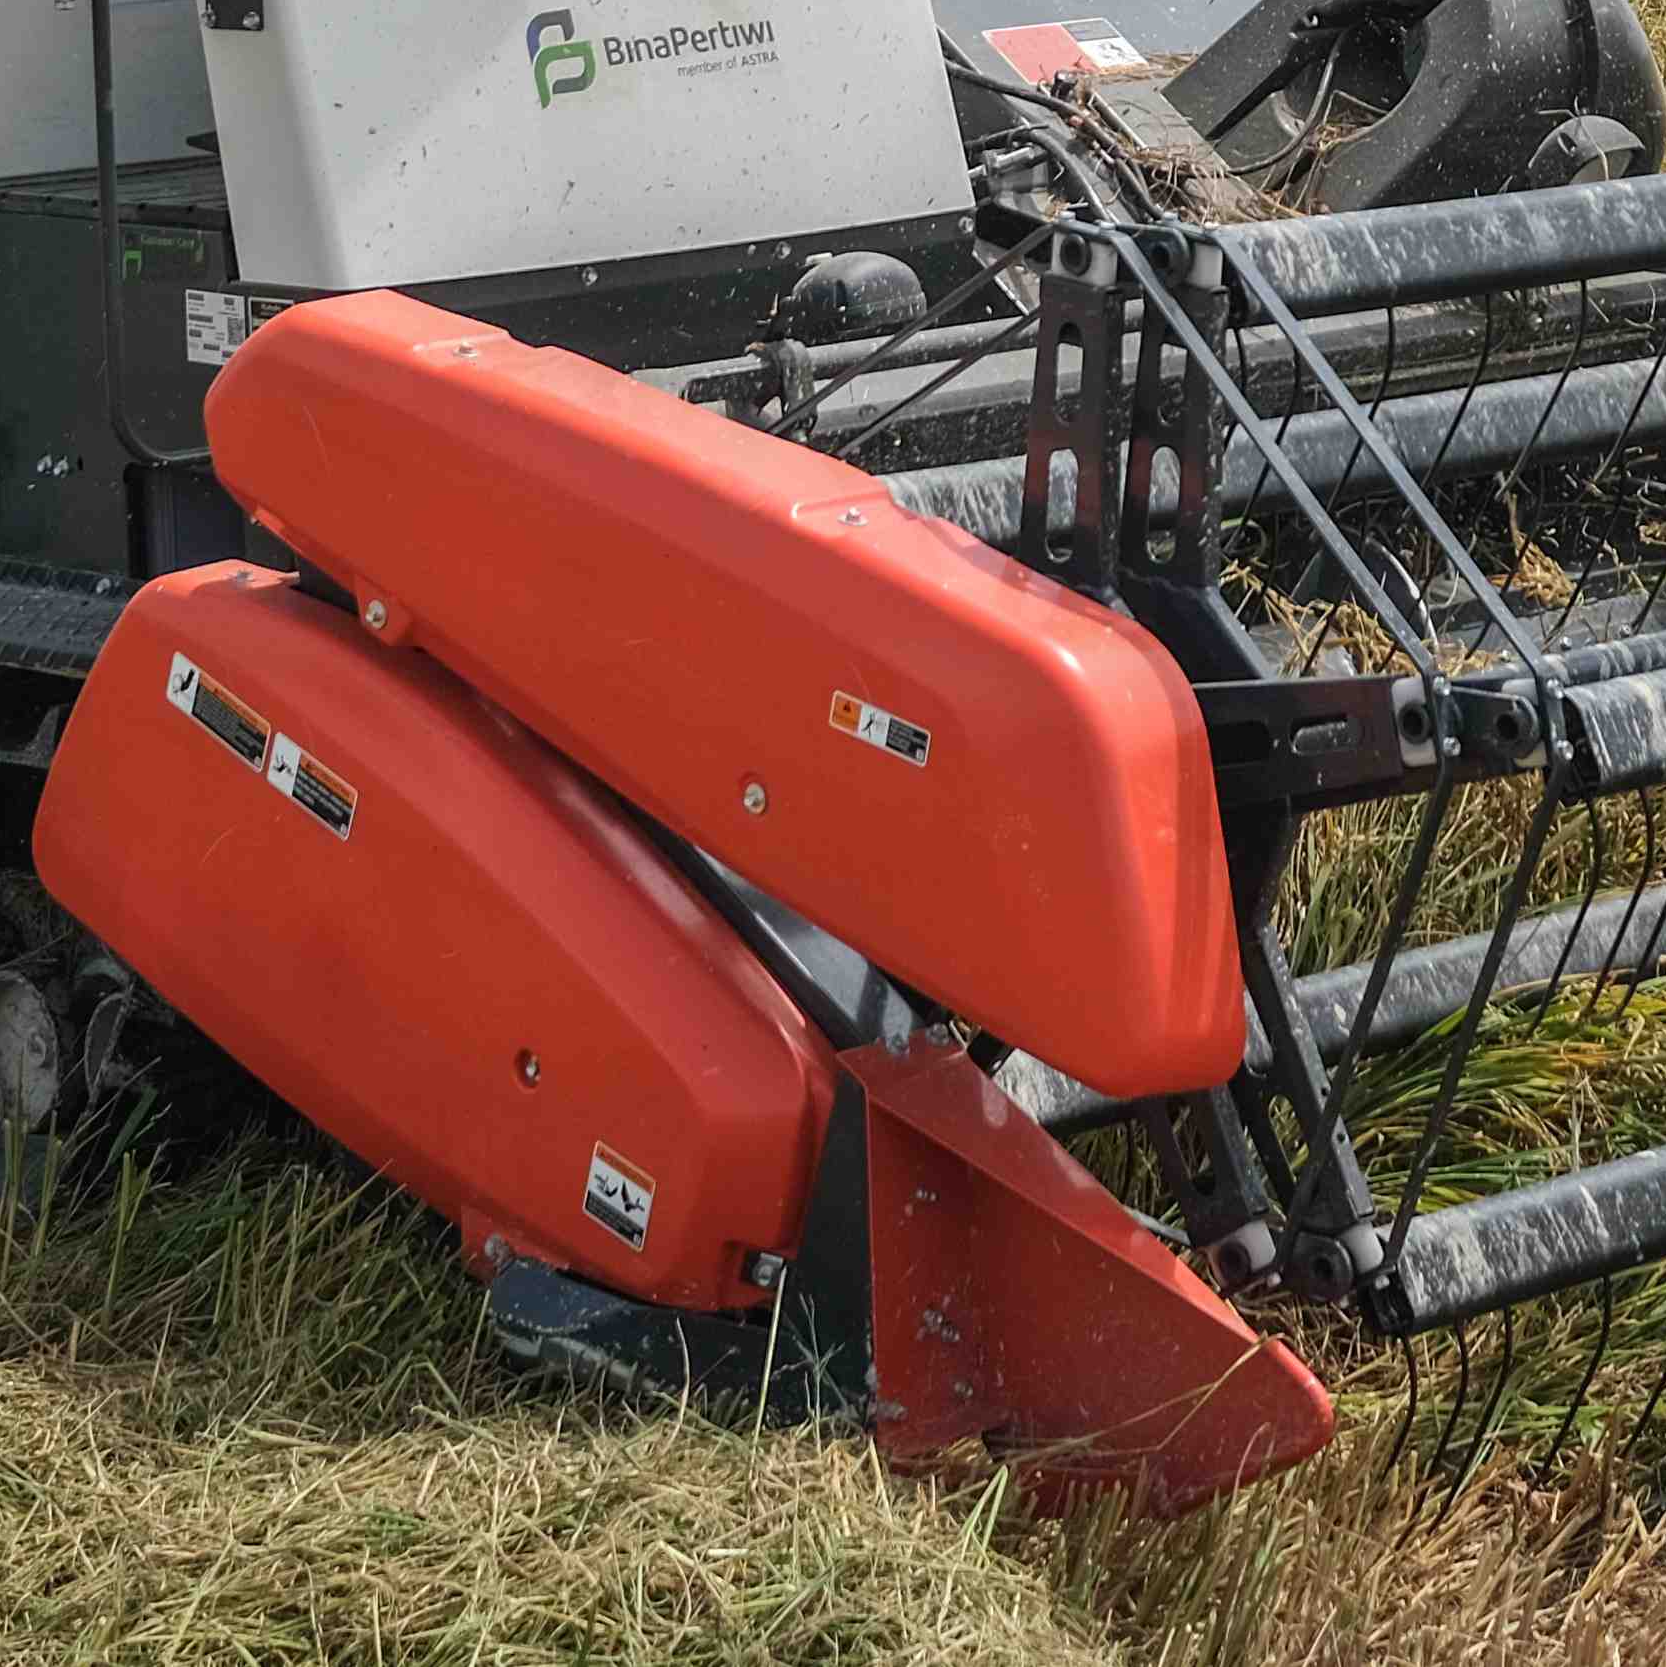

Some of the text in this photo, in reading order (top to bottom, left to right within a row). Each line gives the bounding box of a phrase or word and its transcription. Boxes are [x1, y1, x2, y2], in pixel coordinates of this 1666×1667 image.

[677, 50, 780, 78] member of ASTRA
